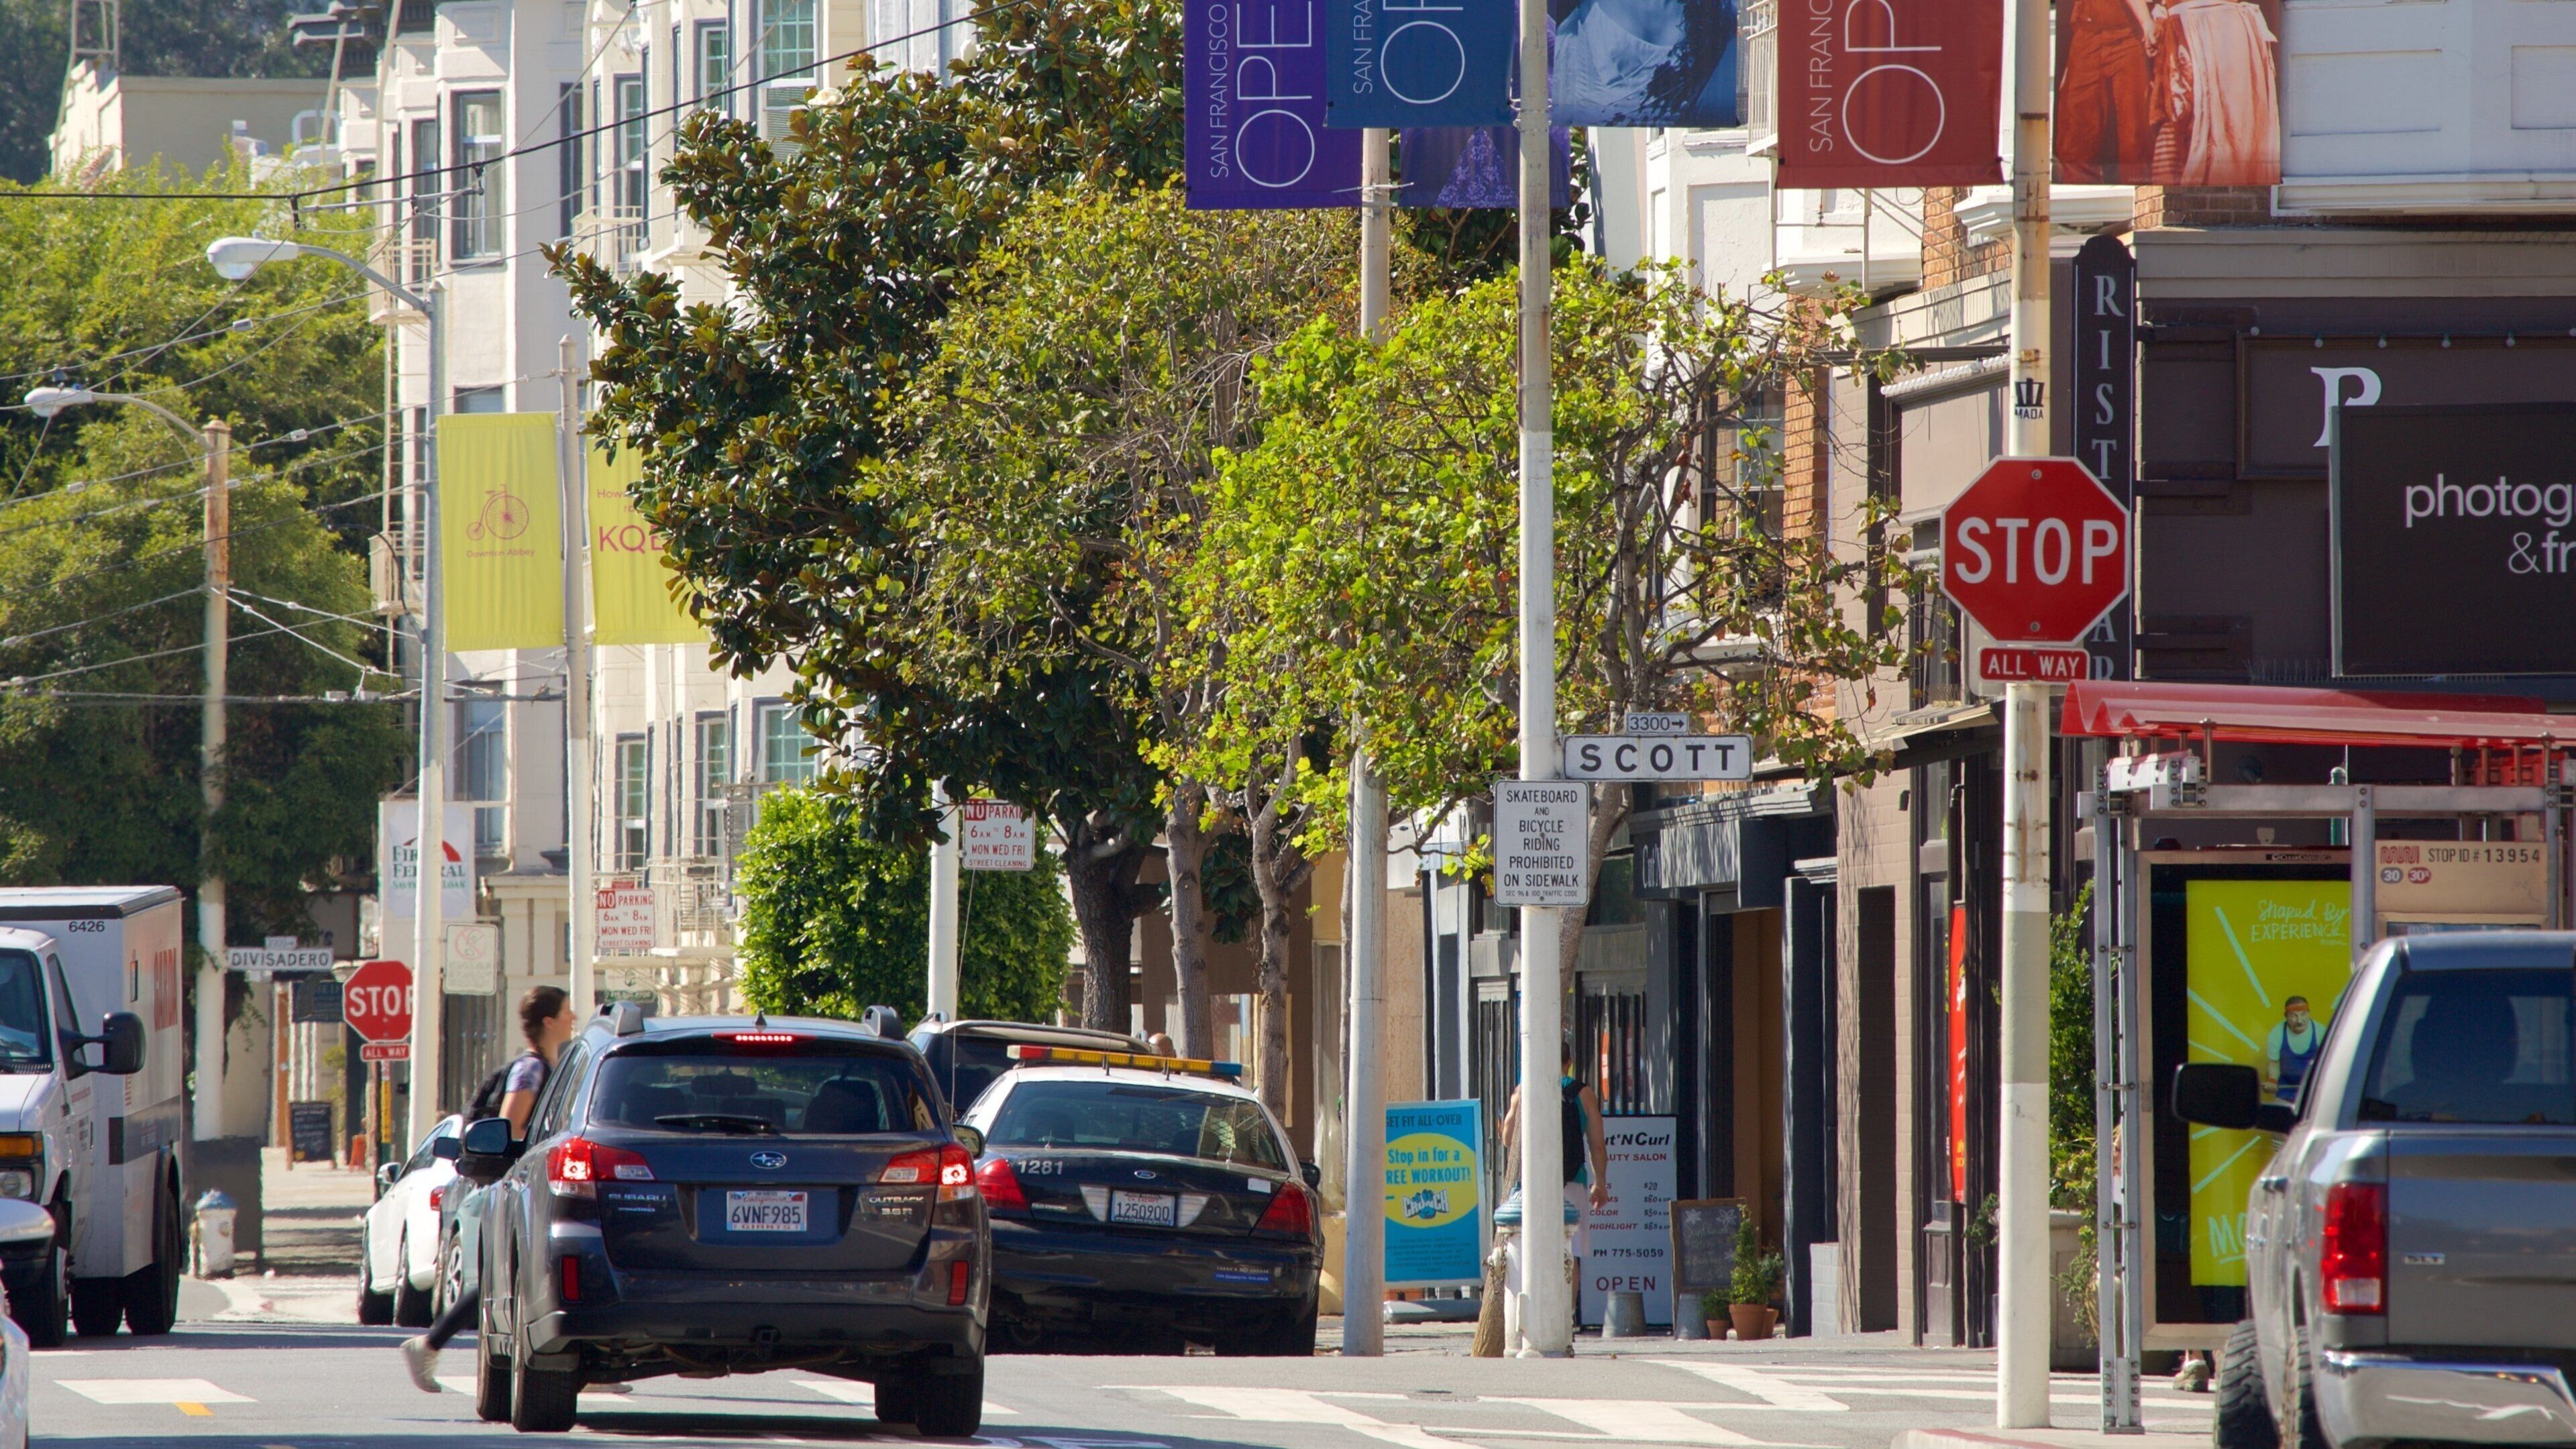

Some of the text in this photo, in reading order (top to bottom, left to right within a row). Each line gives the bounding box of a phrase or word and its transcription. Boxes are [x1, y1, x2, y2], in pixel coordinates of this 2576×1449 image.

[1352, 48, 1373, 94] SAN
[1208, 4, 1229, 178] SAN FRANCISCO
[1809, 97, 1833, 152] SAN
[467, 547, 535, 558] Downton Abbey
[1955, 517, 2119, 586] STOP
[1988, 653, 2080, 678] ALL WAY
[1629, 716, 1670, 731] 3300
[1579, 743, 1735, 773] SCOTT
[1506, 790, 1578, 804] SKATEBOARD
[1534, 806, 1550, 816] AND
[1519, 820, 1564, 833] BICYCLE
[971, 844, 1026, 856] MON WED FRI
[1523, 837, 1560, 851] RIDING
[1509, 855, 1574, 869] PROHIBITED
[2428, 848, 2456, 863] STOP
[2459, 848, 2470, 863] ID
[2484, 849, 2541, 863] 13954
[994, 859, 1028, 867] CLEANING
[1503, 873, 1579, 888] ON SIDEWALK
[2383, 869, 2400, 881] 30
[598, 892, 653, 908] NO PARKING
[1542, 890, 1562, 898] TRAFFIC
[68, 920, 105, 932] 6426
[601, 925, 652, 936] MON WED FRI
[231, 952, 329, 967] DIVISADERO
[365, 1046, 407, 1058] ALL WAY
[1401, 1115, 1415, 1128] FIT
[1388, 1146, 1460, 1167] Stop in for a
[1633, 1153, 1667, 1161] SALON
[1018, 1160, 1064, 1175] 1281
[1385, 1167, 1472, 1185] REE WORKOUT!
[1644, 1181, 1658, 1191] $20
[731, 1206, 801, 1224] 6VNF985
[1117, 1201, 1170, 1222] 1250900
[1593, 1248, 1664, 1258] PH 775-5059
[1596, 1276, 1656, 1291] OPEN
